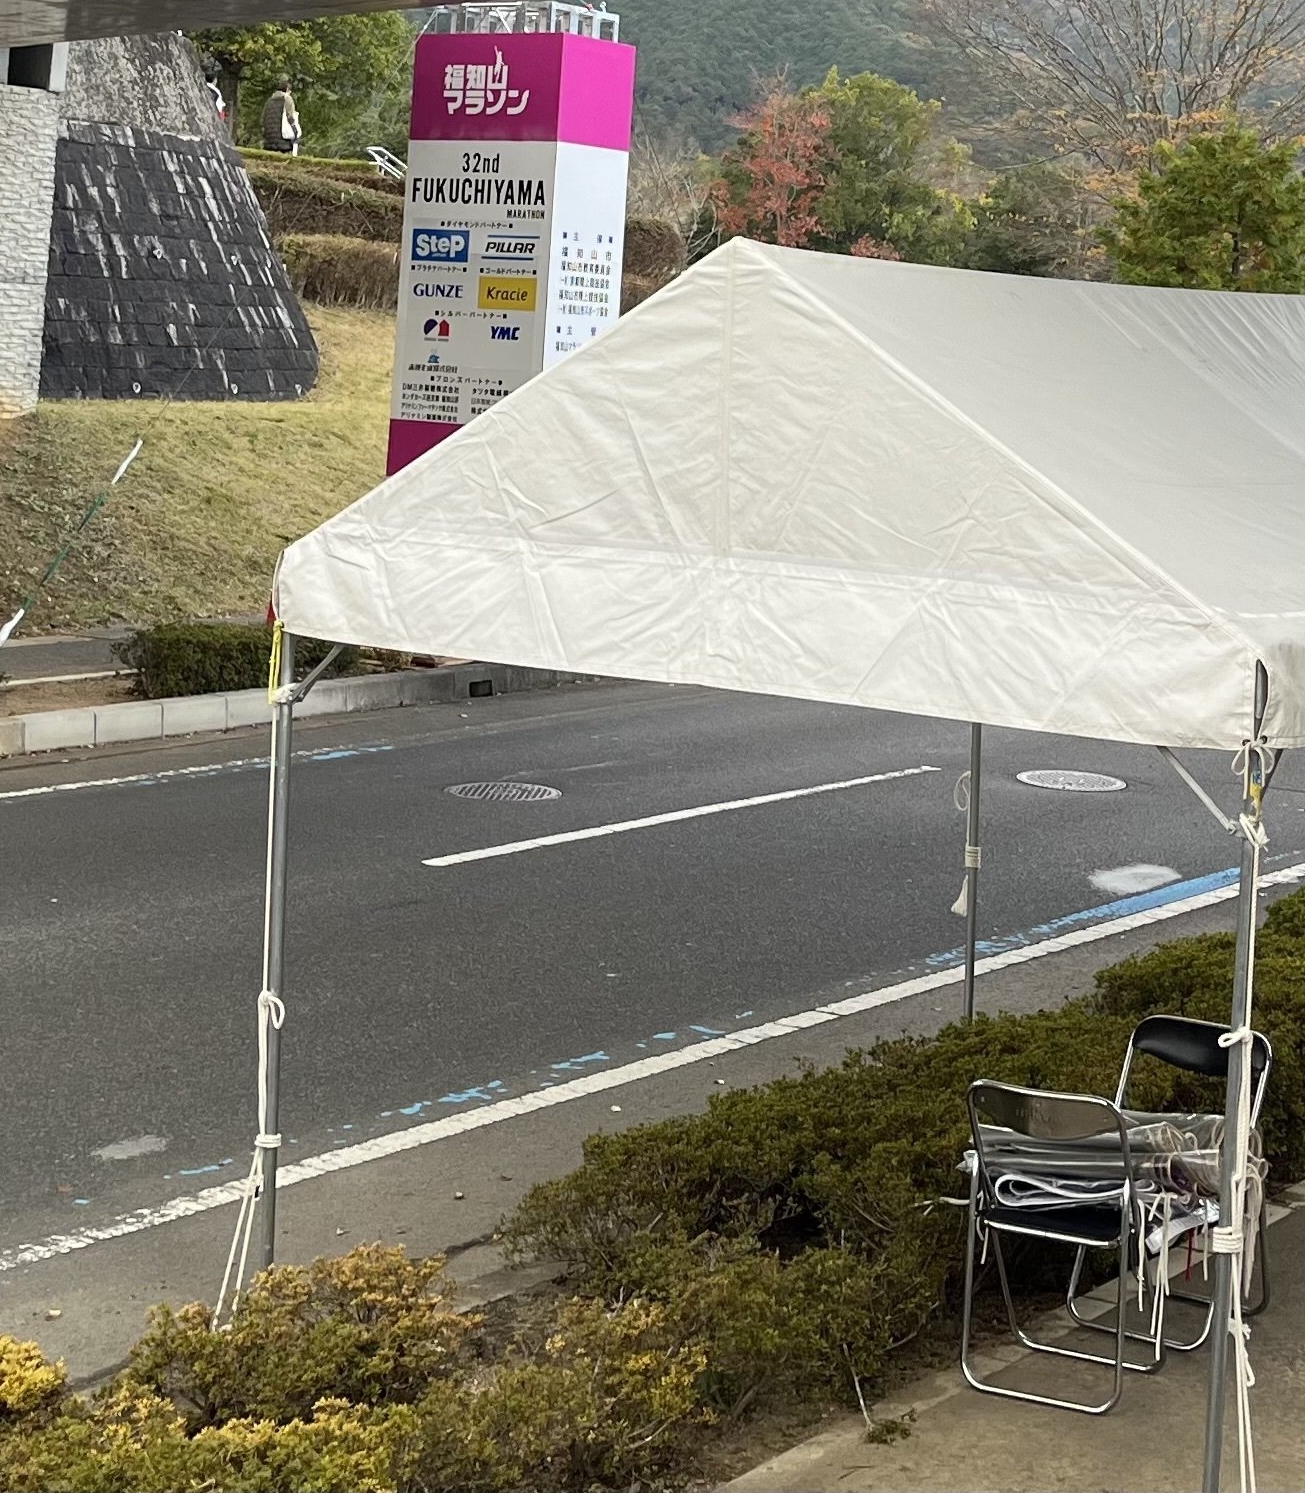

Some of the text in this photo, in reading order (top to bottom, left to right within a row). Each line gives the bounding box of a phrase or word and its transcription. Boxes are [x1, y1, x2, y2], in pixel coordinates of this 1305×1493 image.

[444, 57, 509, 90] 福知山
[443, 89, 530, 115] マラソン
[462, 152, 500, 174] 32nd
[412, 177, 546, 206] FUKUCHIYAMA
[506, 209, 545, 220] MARATHON
[485, 241, 536, 254] PILLAR
[413, 283, 464, 298] GUNZE
[486, 286, 528, 301] Kracie
[490, 325, 521, 341] YMC
